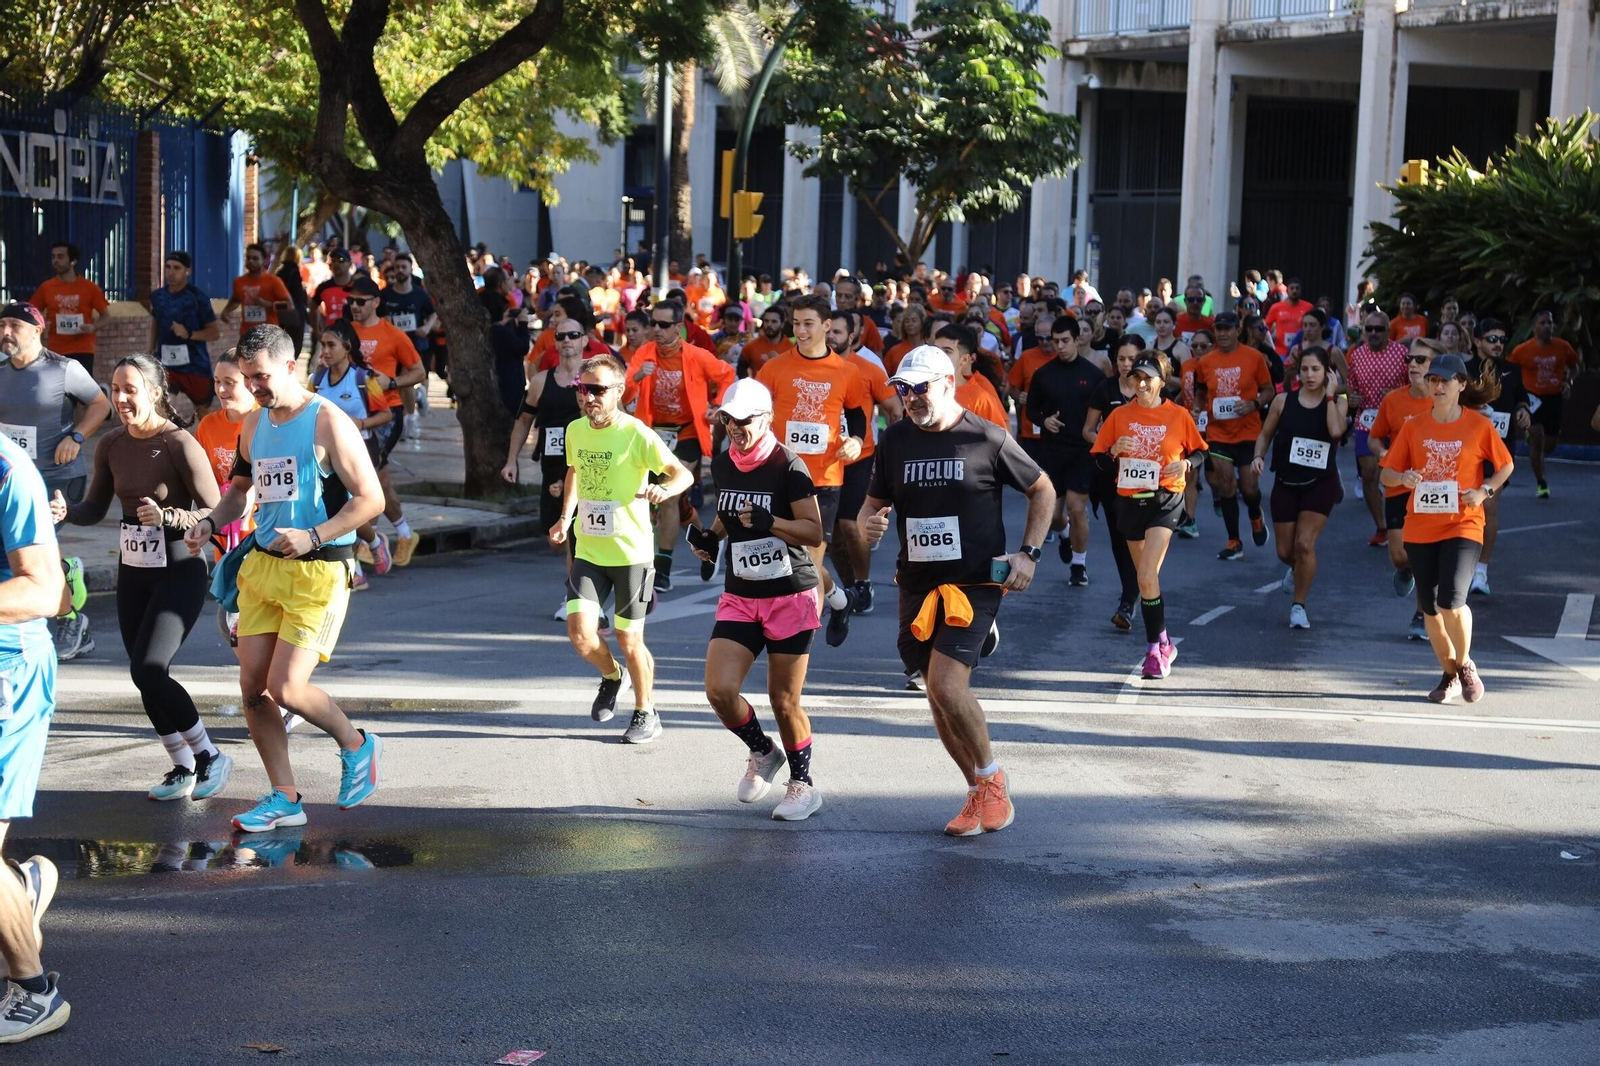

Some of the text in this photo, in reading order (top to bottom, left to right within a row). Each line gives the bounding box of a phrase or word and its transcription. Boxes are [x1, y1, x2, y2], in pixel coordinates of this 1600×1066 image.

[791, 432, 819, 444] 948
[1296, 447, 1322, 459] 595
[903, 460, 964, 484] FITCLUB
[1123, 468, 1155, 480] 1021
[258, 472, 294, 487] 1018
[1420, 493, 1449, 504] 421
[587, 513, 606, 526] 14
[124, 538, 160, 553] 1017
[910, 532, 954, 547] 1086
[738, 549, 784, 569] 1054
